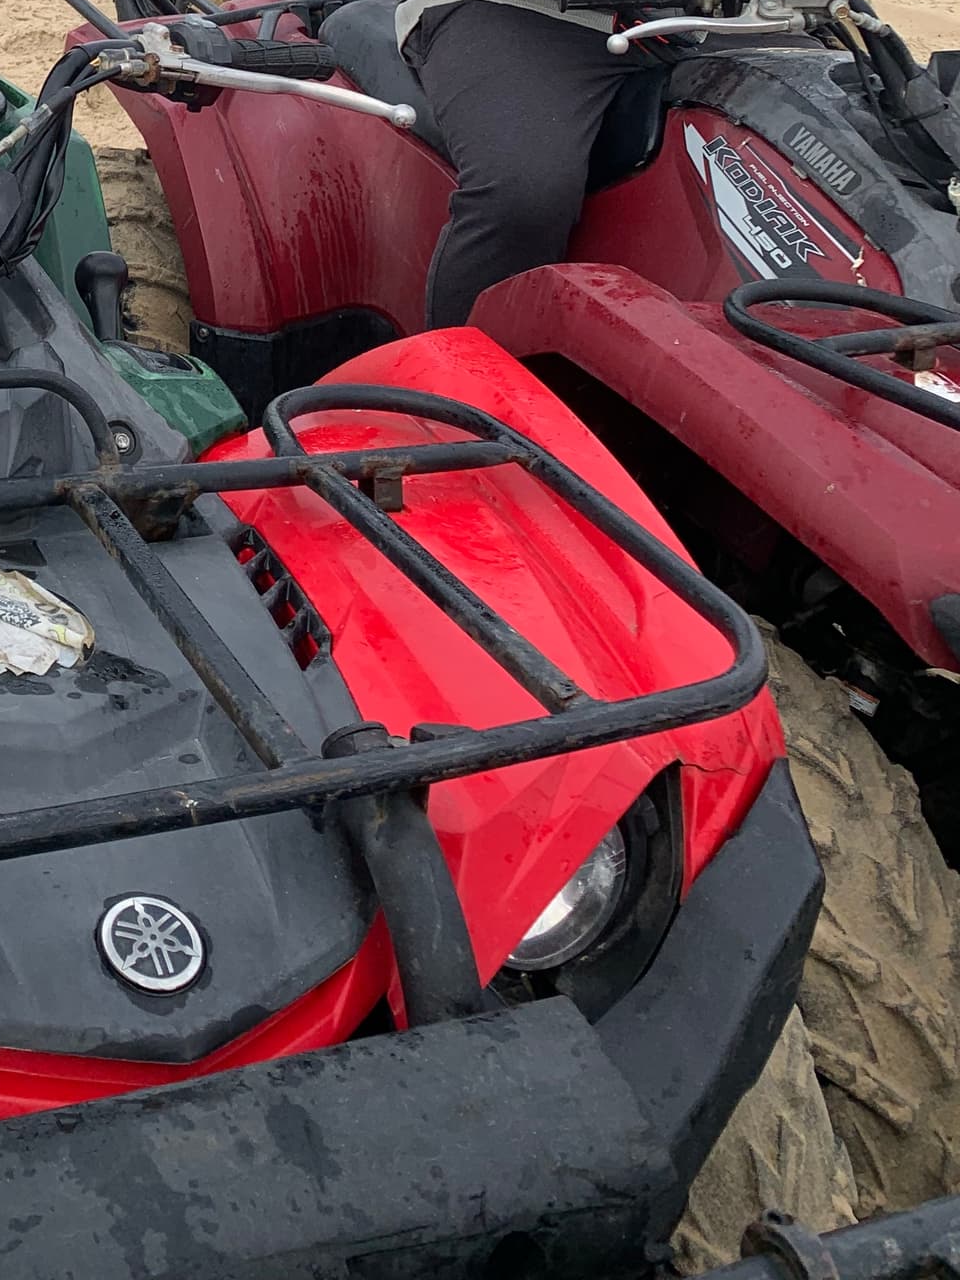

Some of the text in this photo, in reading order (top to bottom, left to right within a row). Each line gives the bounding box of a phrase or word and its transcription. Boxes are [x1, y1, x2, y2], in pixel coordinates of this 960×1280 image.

[789, 126, 856, 191] YAMAHA
[703, 136, 825, 262] KODIAK
[748, 163, 810, 227] FUEL INJECTION
[742, 214, 792, 269] 450
